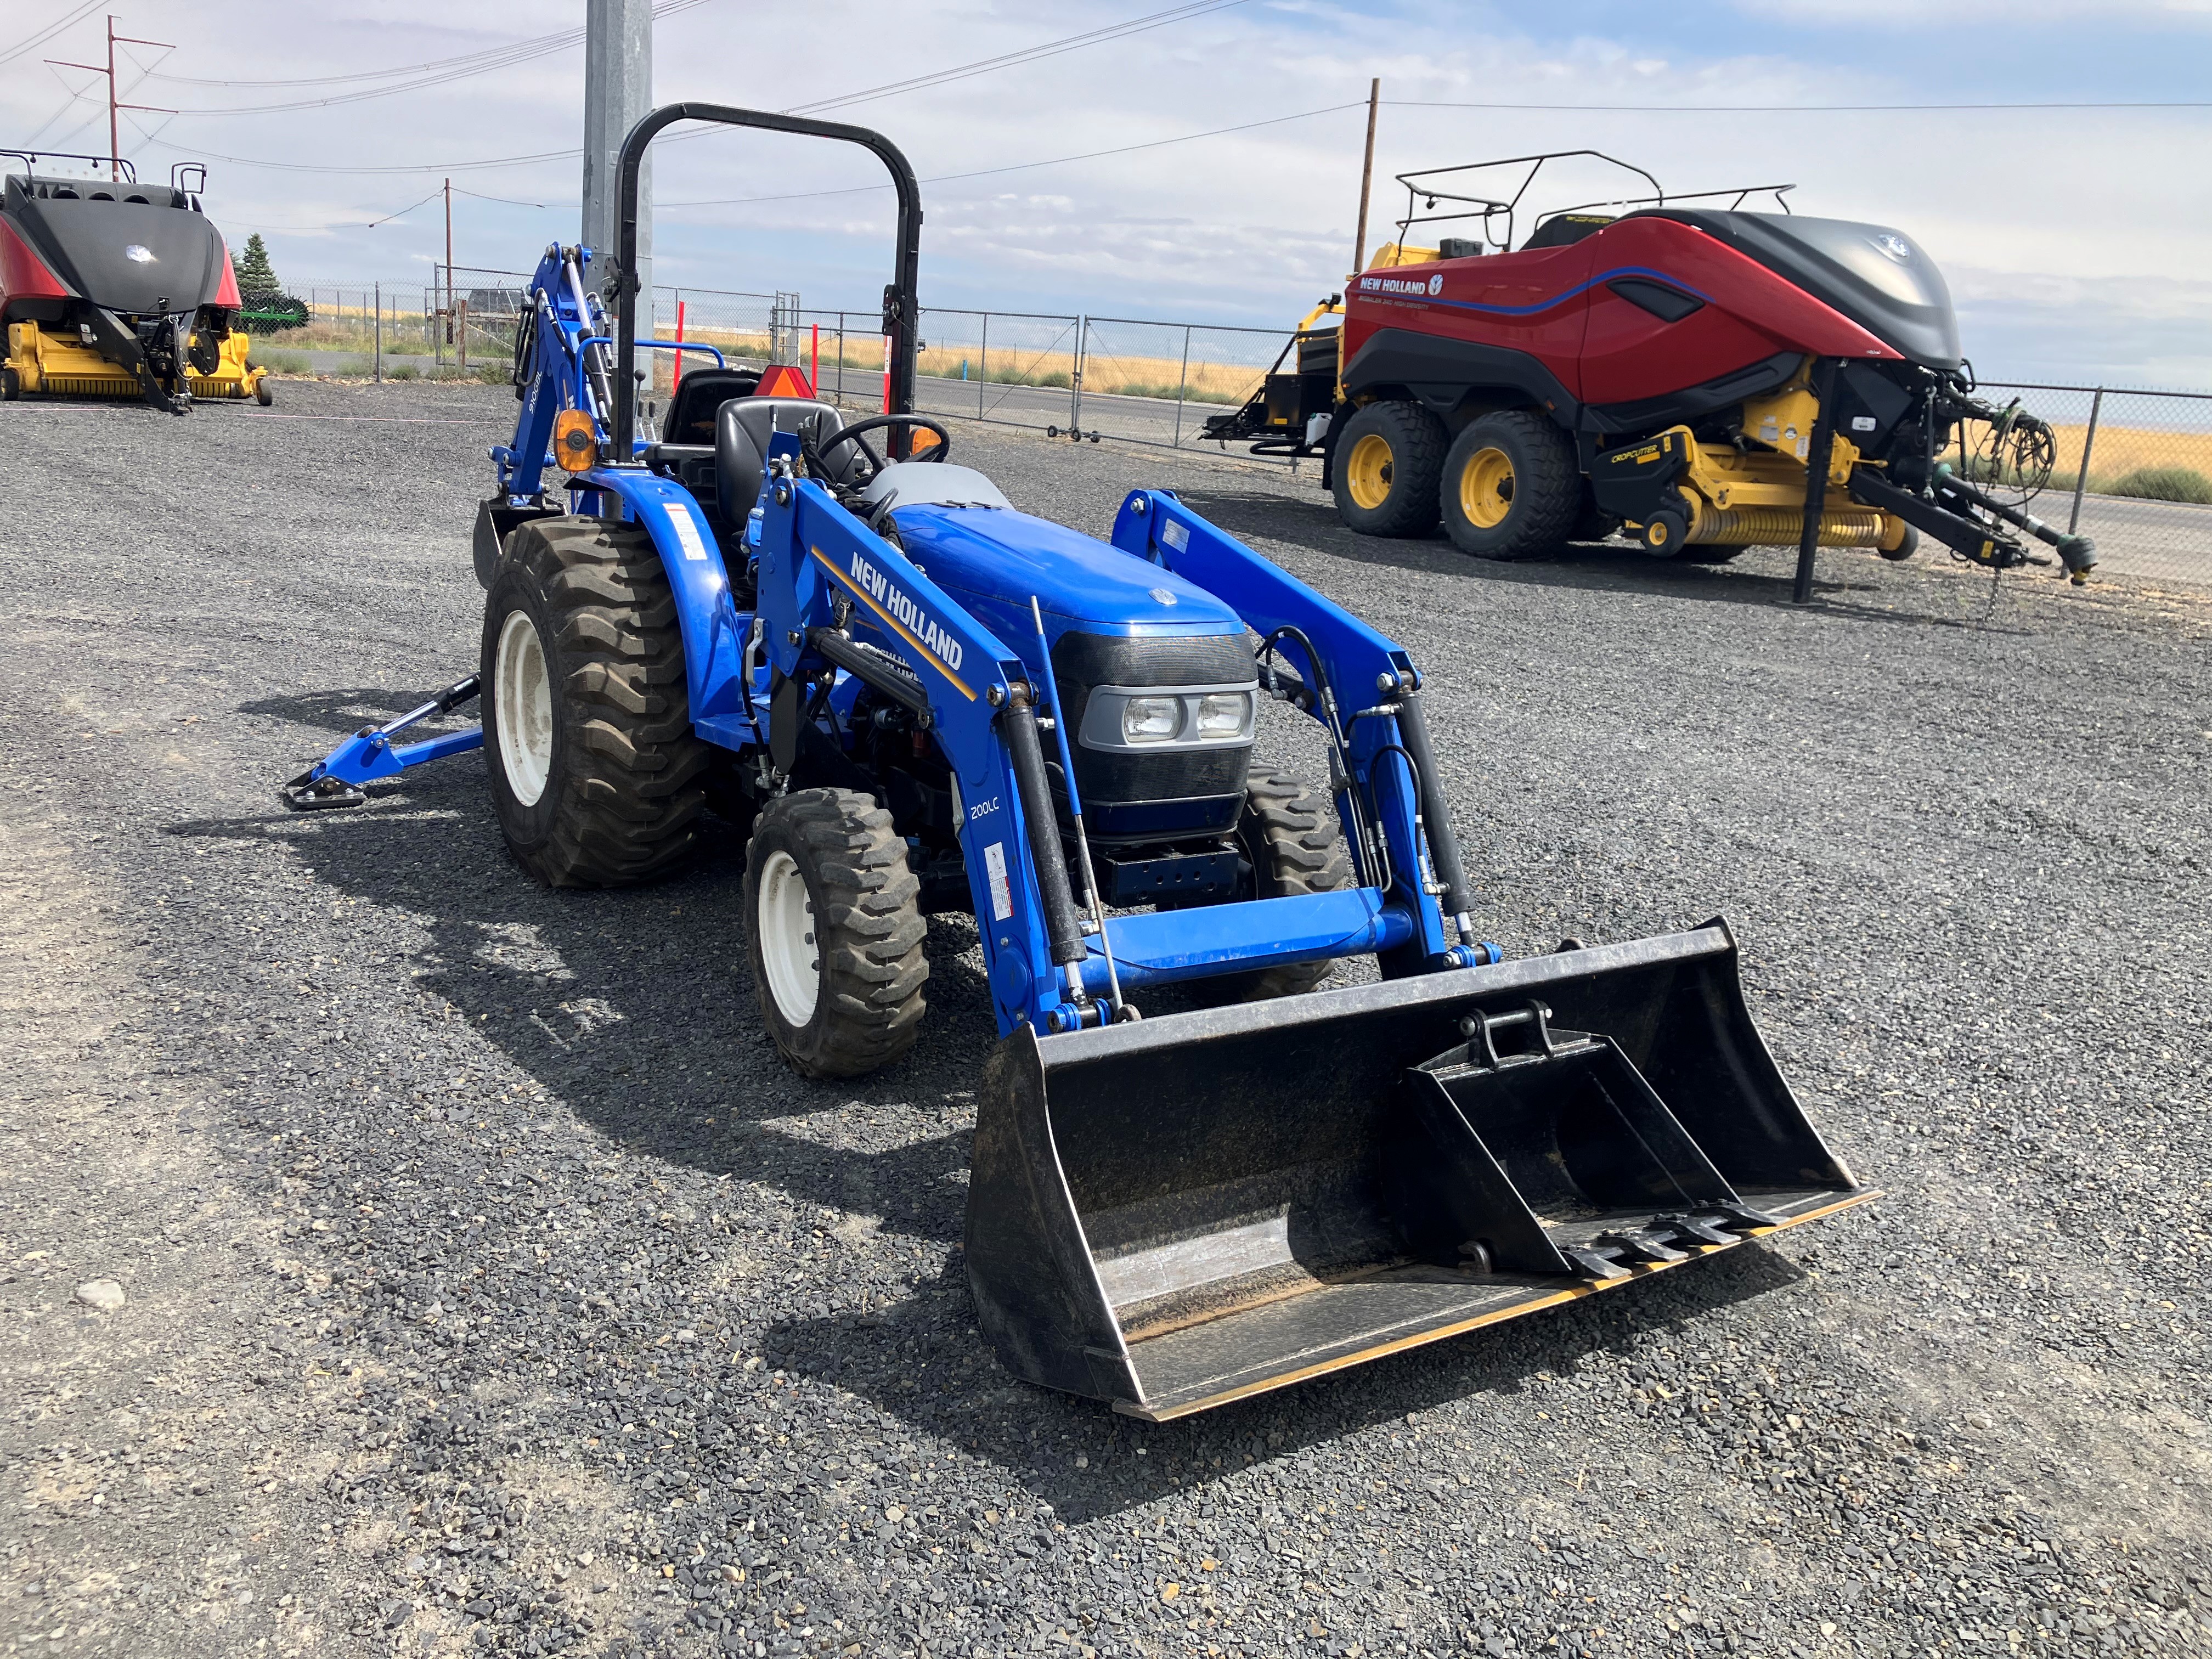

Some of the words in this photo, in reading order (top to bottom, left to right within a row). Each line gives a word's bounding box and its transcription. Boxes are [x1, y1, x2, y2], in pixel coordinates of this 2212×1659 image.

[1360, 277, 1382, 290] NEW
[1382, 279, 1426, 295] HOLLAND
[1612, 445, 1657, 462] CROPCUTTER
[851, 551, 887, 602] NEW
[887, 584, 963, 672] HOLLAND
[970, 796, 1000, 820] 200LC
